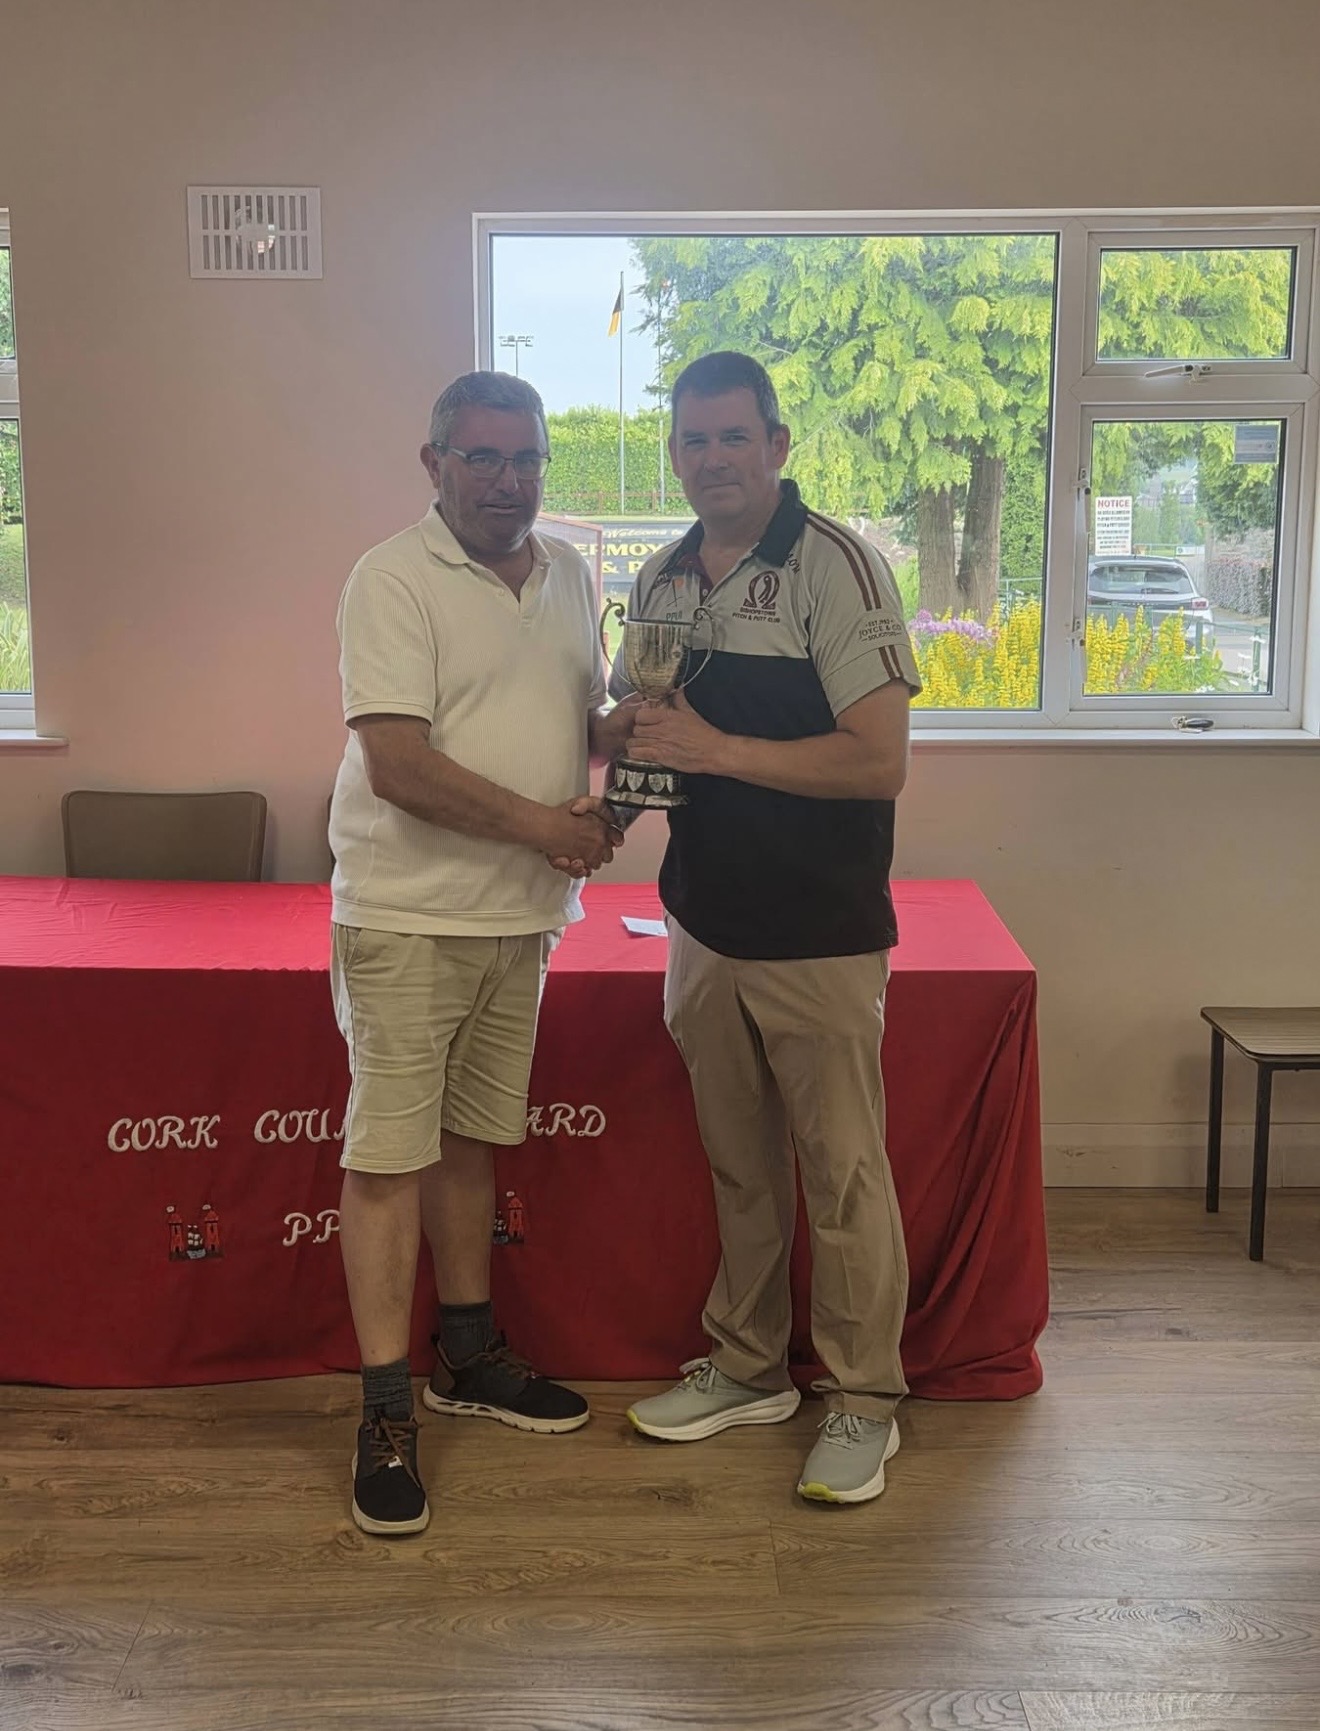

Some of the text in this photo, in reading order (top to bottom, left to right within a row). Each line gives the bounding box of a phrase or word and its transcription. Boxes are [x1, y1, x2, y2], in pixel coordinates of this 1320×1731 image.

[1097, 499, 1131, 508] NOTICE
[858, 625, 883, 639] JOYCE
[107, 1114, 222, 1152] CORK
